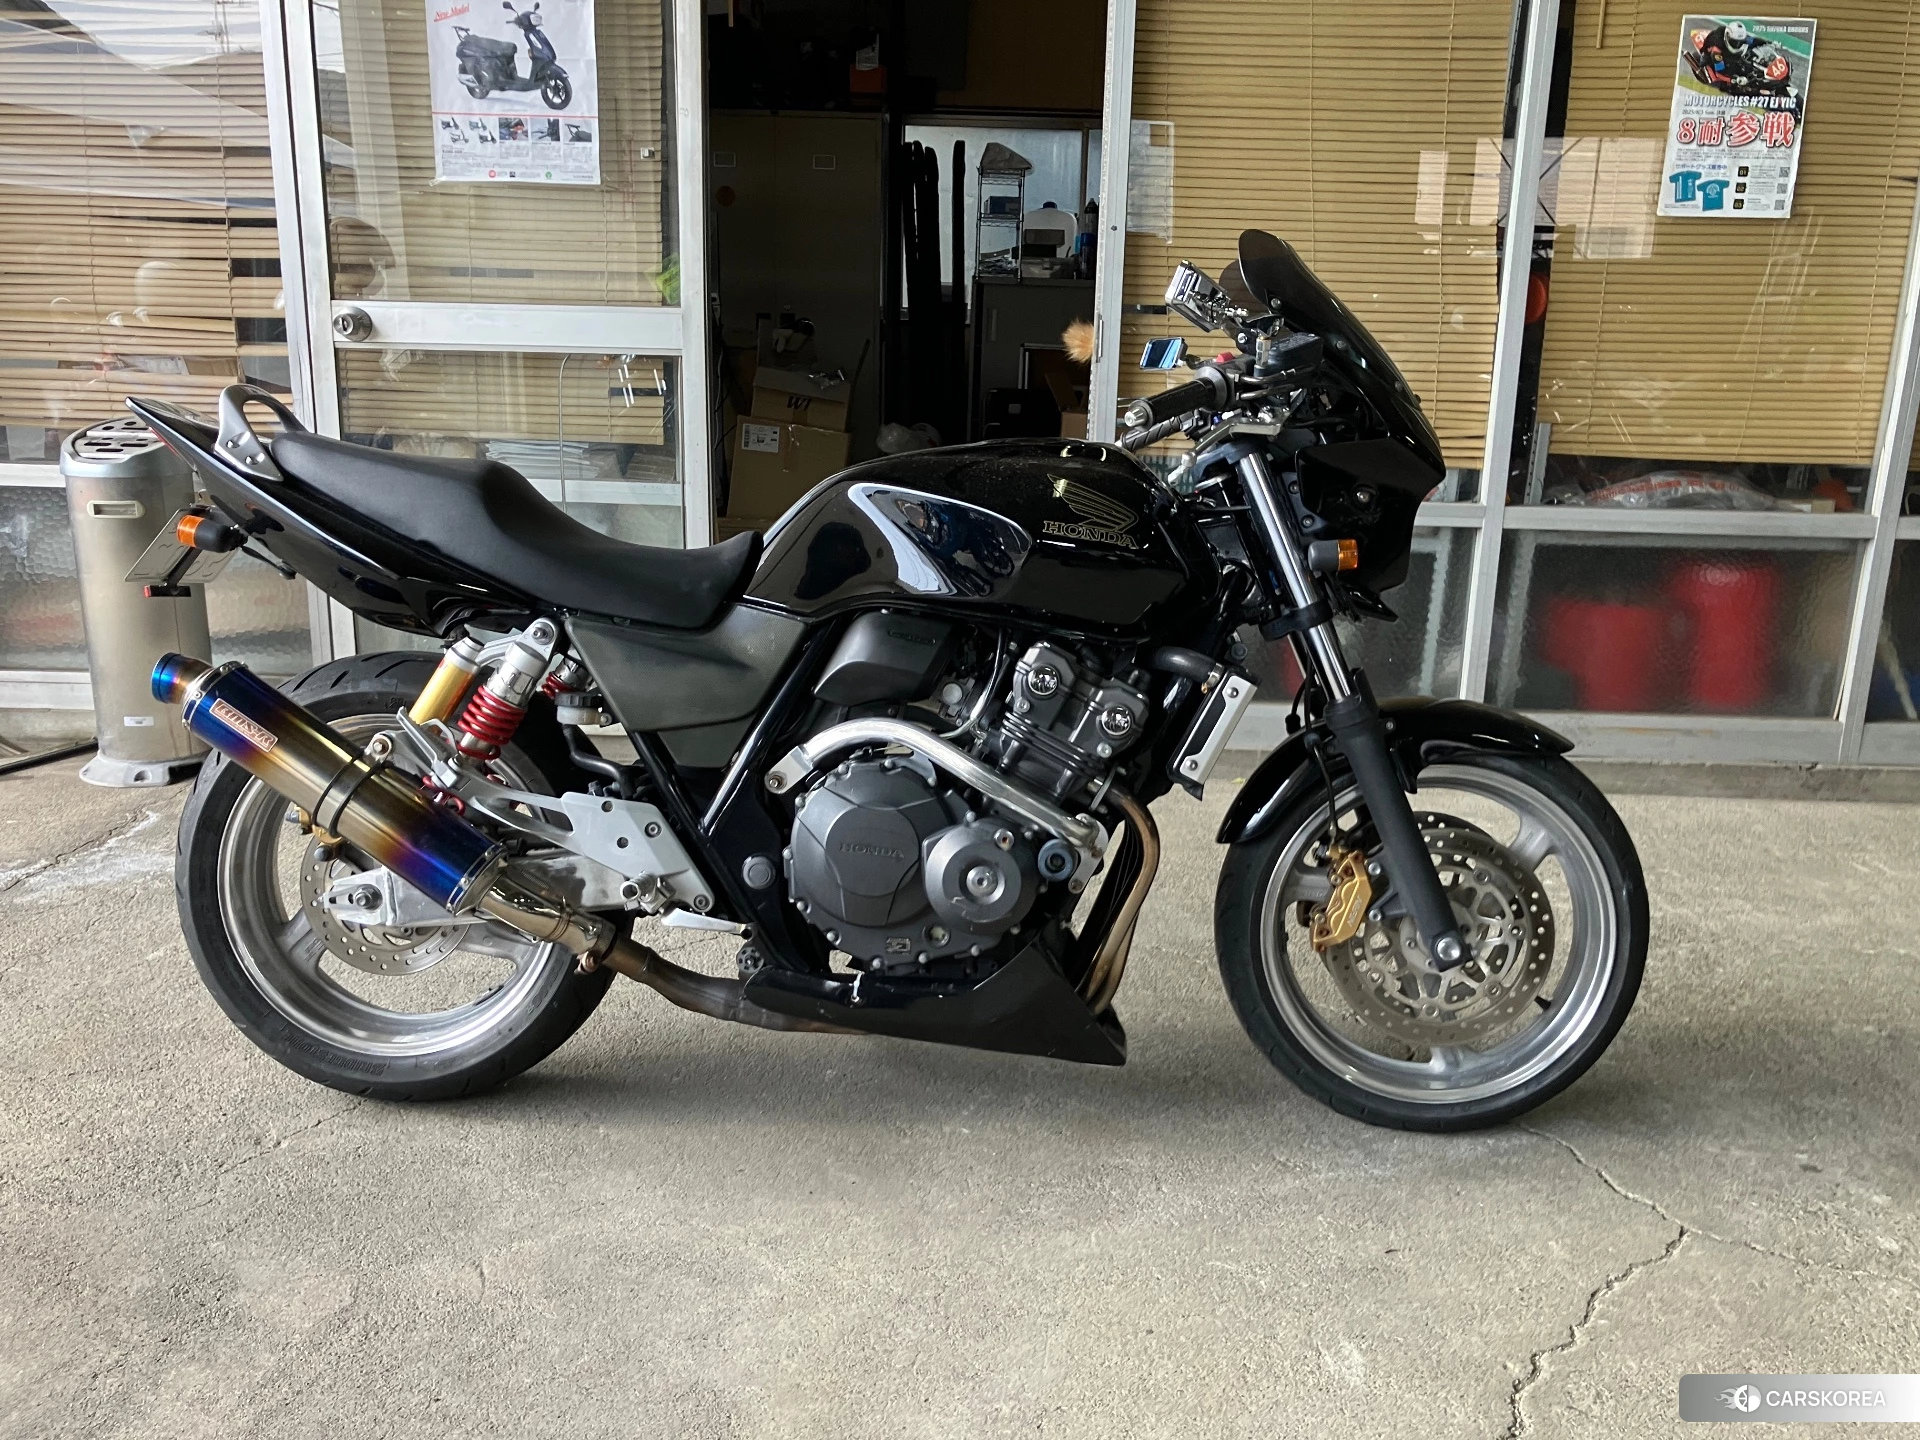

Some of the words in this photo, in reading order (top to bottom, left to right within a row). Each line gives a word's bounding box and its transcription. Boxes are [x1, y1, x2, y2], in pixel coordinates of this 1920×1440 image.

[435, 8, 450, 20] New
[451, 3, 470, 16] Model
[1771, 63, 1786, 77] 46
[1684, 94, 1750, 107] MOTORCYCLES
[1677, 110, 1796, 148] 8耐参戦
[1043, 520, 1139, 550] HONDA
[840, 842, 905, 859] HONDA
